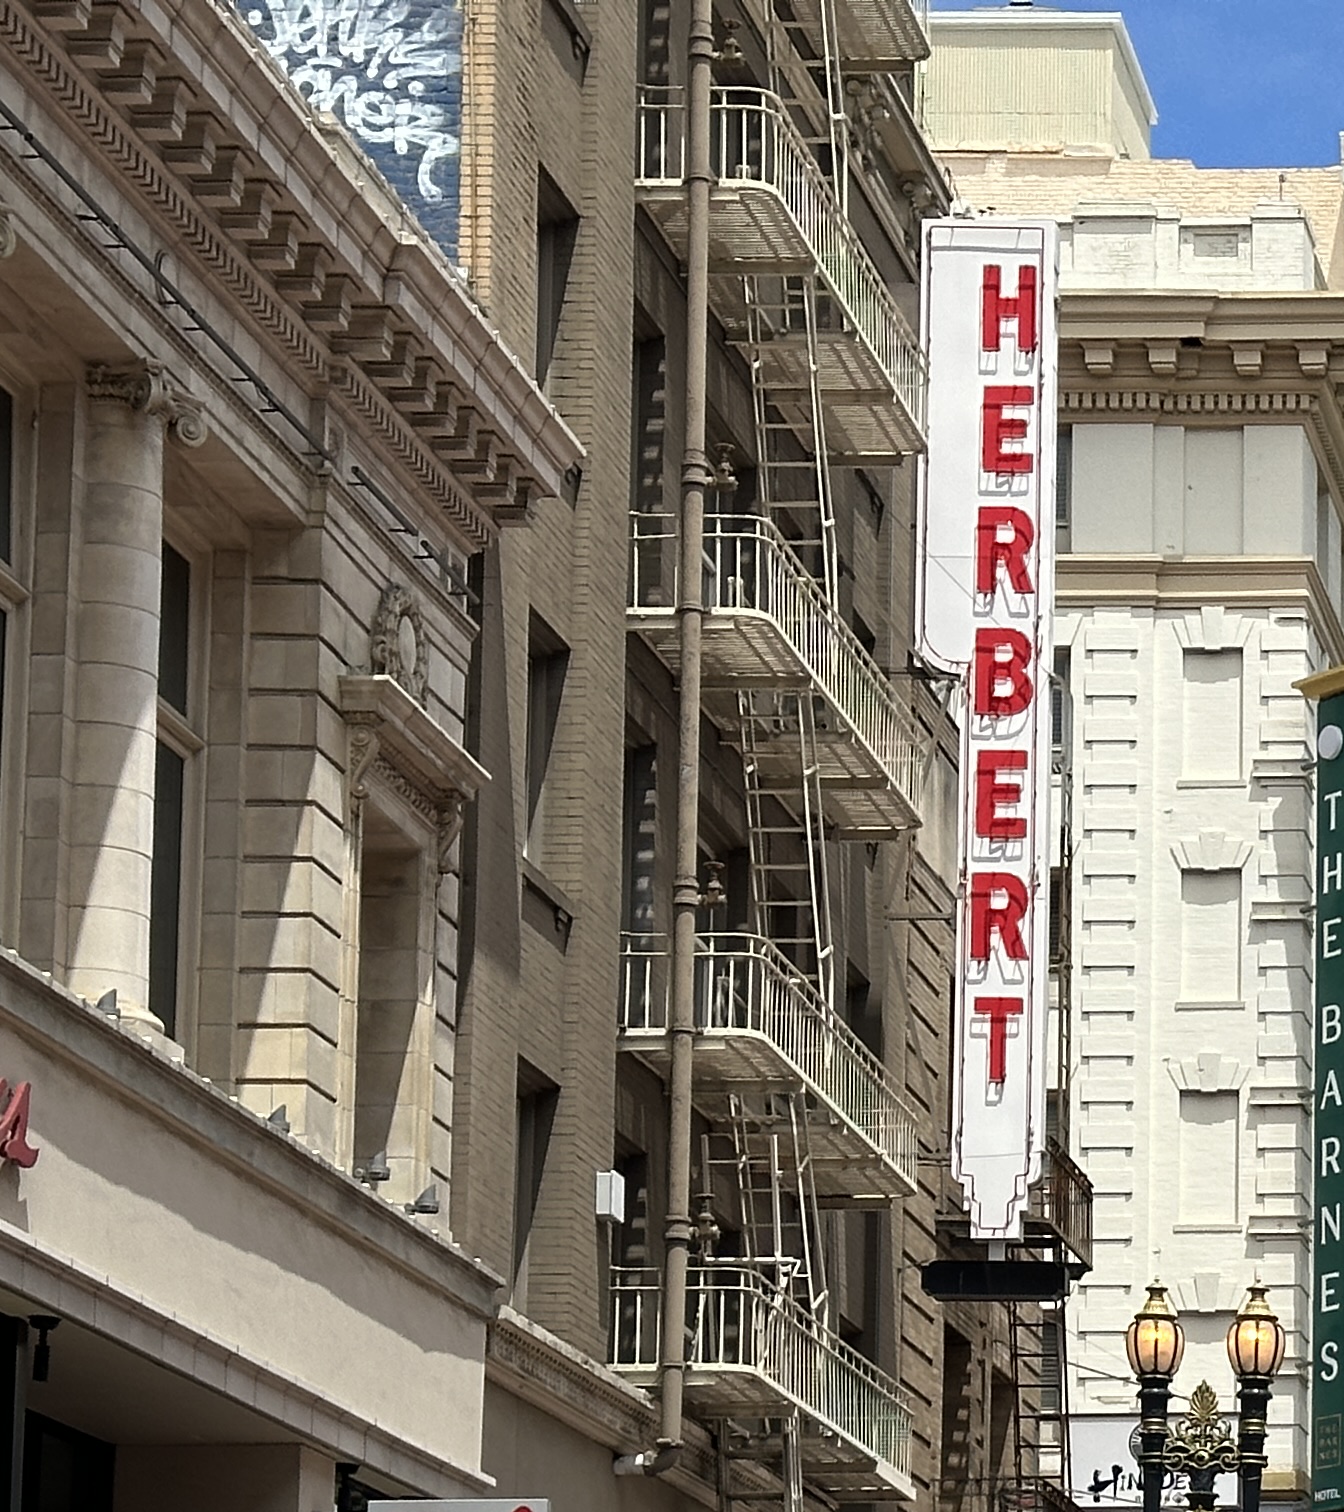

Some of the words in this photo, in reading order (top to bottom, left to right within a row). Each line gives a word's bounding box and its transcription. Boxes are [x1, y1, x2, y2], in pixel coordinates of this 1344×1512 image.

[970, 264, 1037, 1085] HERBERT
[1322, 790, 1342, 958] THE
[1320, 1004, 1342, 1382] BARNES
[1314, 1488, 1341, 1501] HOTEL
